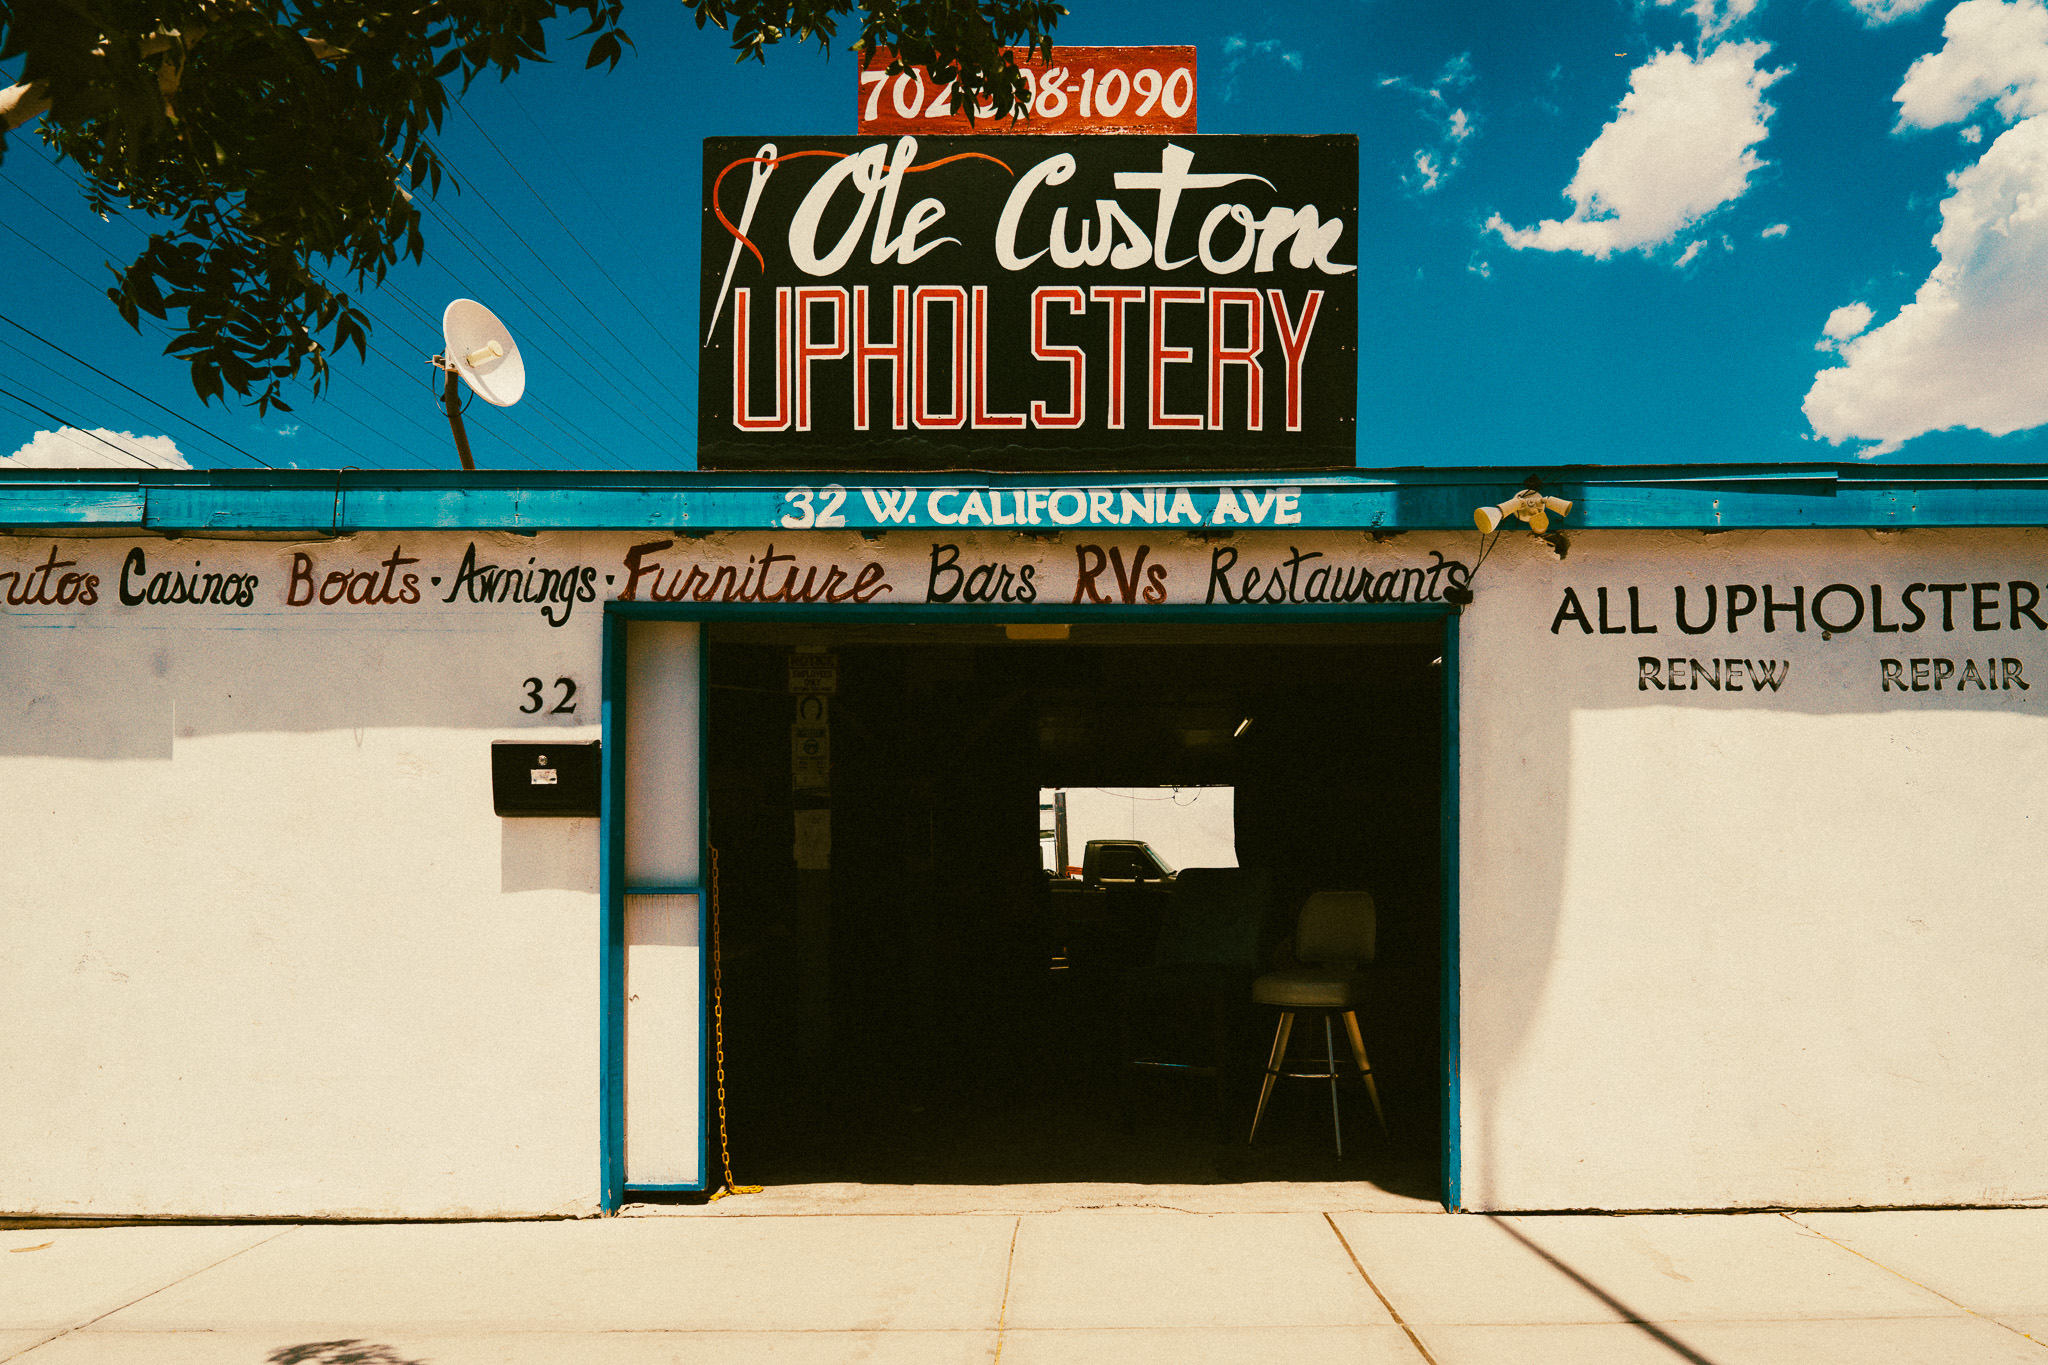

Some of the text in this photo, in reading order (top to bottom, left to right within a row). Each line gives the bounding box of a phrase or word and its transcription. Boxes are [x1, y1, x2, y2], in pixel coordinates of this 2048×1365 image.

[788, 136, 1357, 276] Ole Custom
[733, 286, 1324, 431] UPHOLSTERY
[780, 484, 1302, 528] 32 W. CALIFORNIA AVE
[0, 540, 1470, 627] utos Casinos Boats Awnings Furniture Bars RVs Restaurants
[1551, 581, 2048, 635] ALL UPHOLSTER
[519, 677, 577, 714] 32
[1638, 656, 2030, 692] RENEW REPAIR
